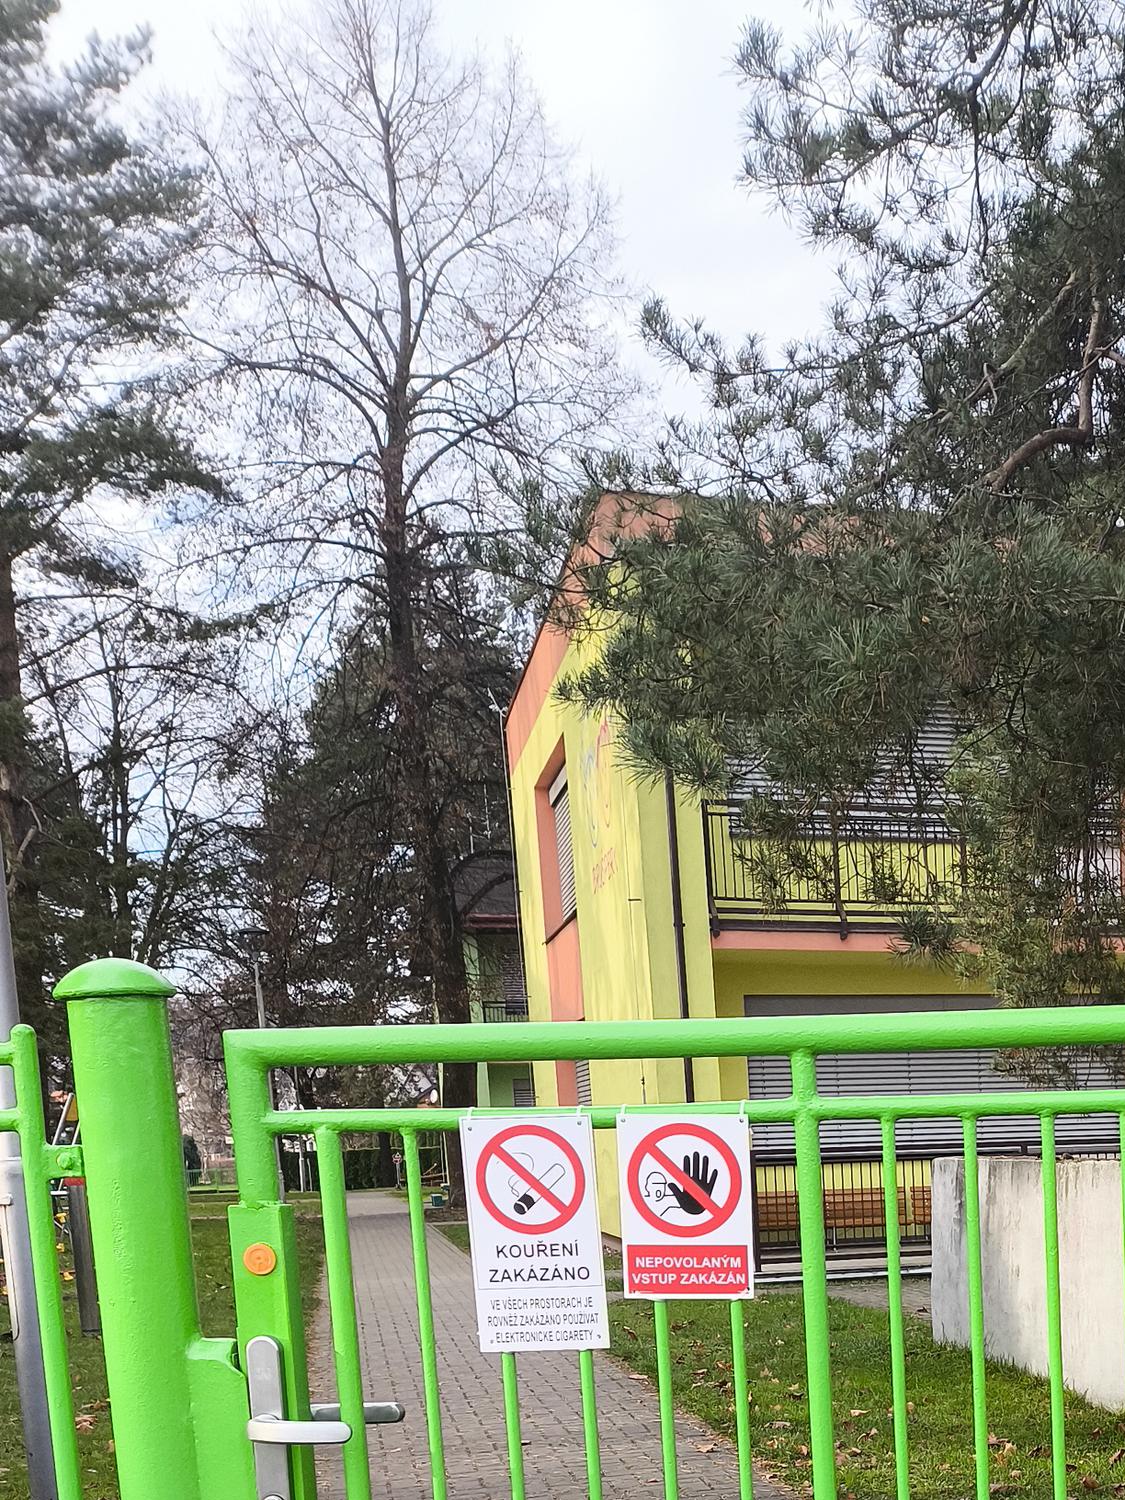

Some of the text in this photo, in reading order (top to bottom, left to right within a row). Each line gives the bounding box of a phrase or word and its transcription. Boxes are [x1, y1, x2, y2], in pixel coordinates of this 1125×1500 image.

[496, 1239, 579, 1258] KOUŘENÍ
[635, 1254, 742, 1268] NEPOVOLANÝM
[489, 1264, 590, 1283] ZAKÁZÁNO
[632, 1271, 746, 1285] VSTUP ZAKÁZÁN
[490, 1300, 501, 1311] VE
[502, 1296, 528, 1310] VŠECH
[584, 1296, 594, 1308] JE
[555, 1329, 594, 1341] CIGARETY
